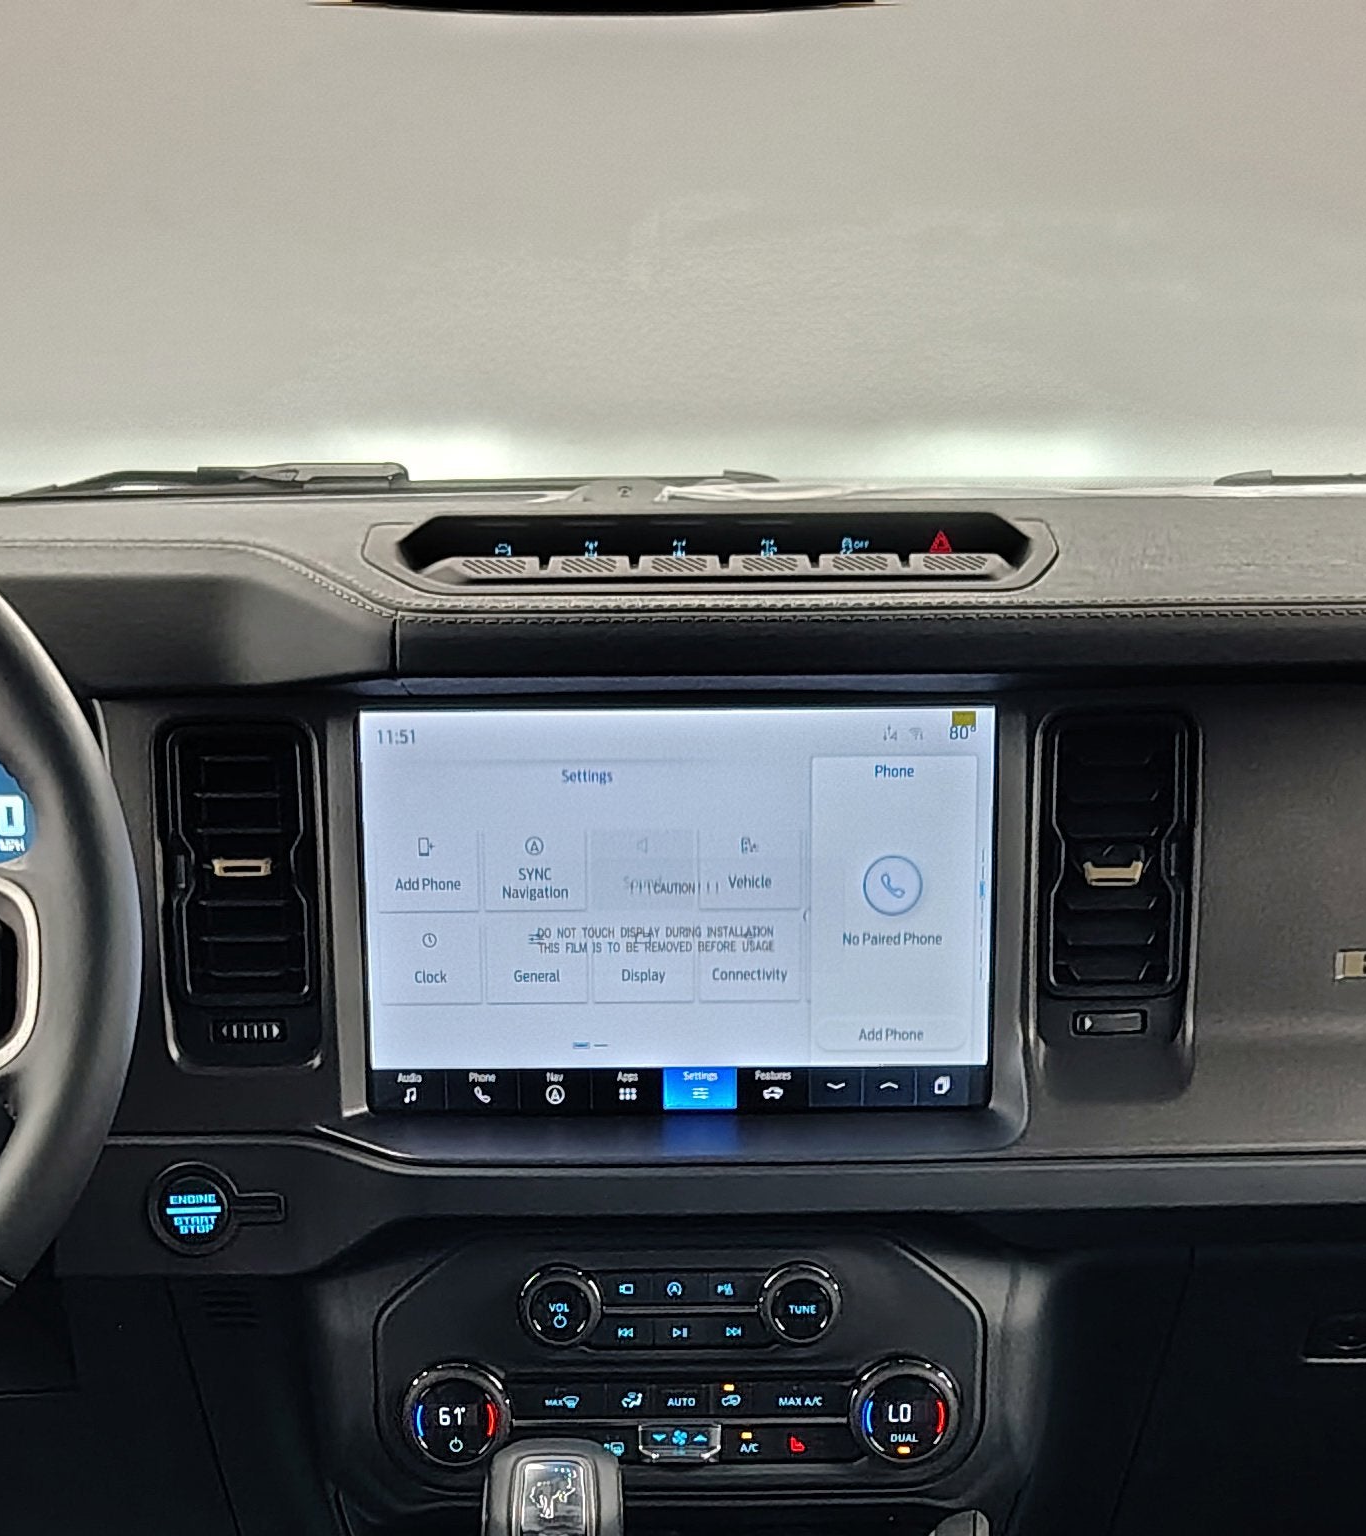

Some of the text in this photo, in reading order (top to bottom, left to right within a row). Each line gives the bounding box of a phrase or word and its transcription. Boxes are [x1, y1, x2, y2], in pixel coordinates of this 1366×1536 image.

[377, 728, 417, 746] 11:51
[561, 768, 613, 785] Settings
[874, 763, 915, 779] Phone
[518, 867, 552, 881] SYNC
[395, 877, 462, 891] Add Phone
[653, 881, 696, 895] CAUTION
[727, 874, 772, 890] Vehicle
[502, 885, 569, 902] Navigation
[537, 925, 775, 939] DO NOT TOUCH DISPLAY DURING INSTALLATION
[842, 931, 943, 946] No Paired Phone
[538, 940, 775, 954] THIS FILM IS TO BE REMOVED BEFORE USAGE
[413, 967, 448, 985] Clock
[512, 968, 561, 984] General
[621, 967, 666, 984] Display
[712, 967, 788, 983] Connectivity
[858, 1028, 924, 1042] Add Phone
[396, 1072, 423, 1084] Audio
[468, 1071, 497, 1083] Phone
[546, 1071, 565, 1083] Nav
[616, 1070, 639, 1083] Apps
[682, 1070, 719, 1082] Settings
[754, 1069, 792, 1081] Features
[169, 1193, 217, 1205] ENGINE
[173, 1215, 218, 1226] START
[179, 1224, 214, 1235] STOP
[548, 1302, 570, 1313] VOL
[788, 1304, 817, 1315] TUNE
[544, 1398, 563, 1407] MAX
[666, 1396, 696, 1407] AUTO
[778, 1395, 823, 1407] MAX A/C
[887, 1403, 912, 1423] LO
[889, 1432, 919, 1443] DUAL
[740, 1442, 759, 1453] A/C
